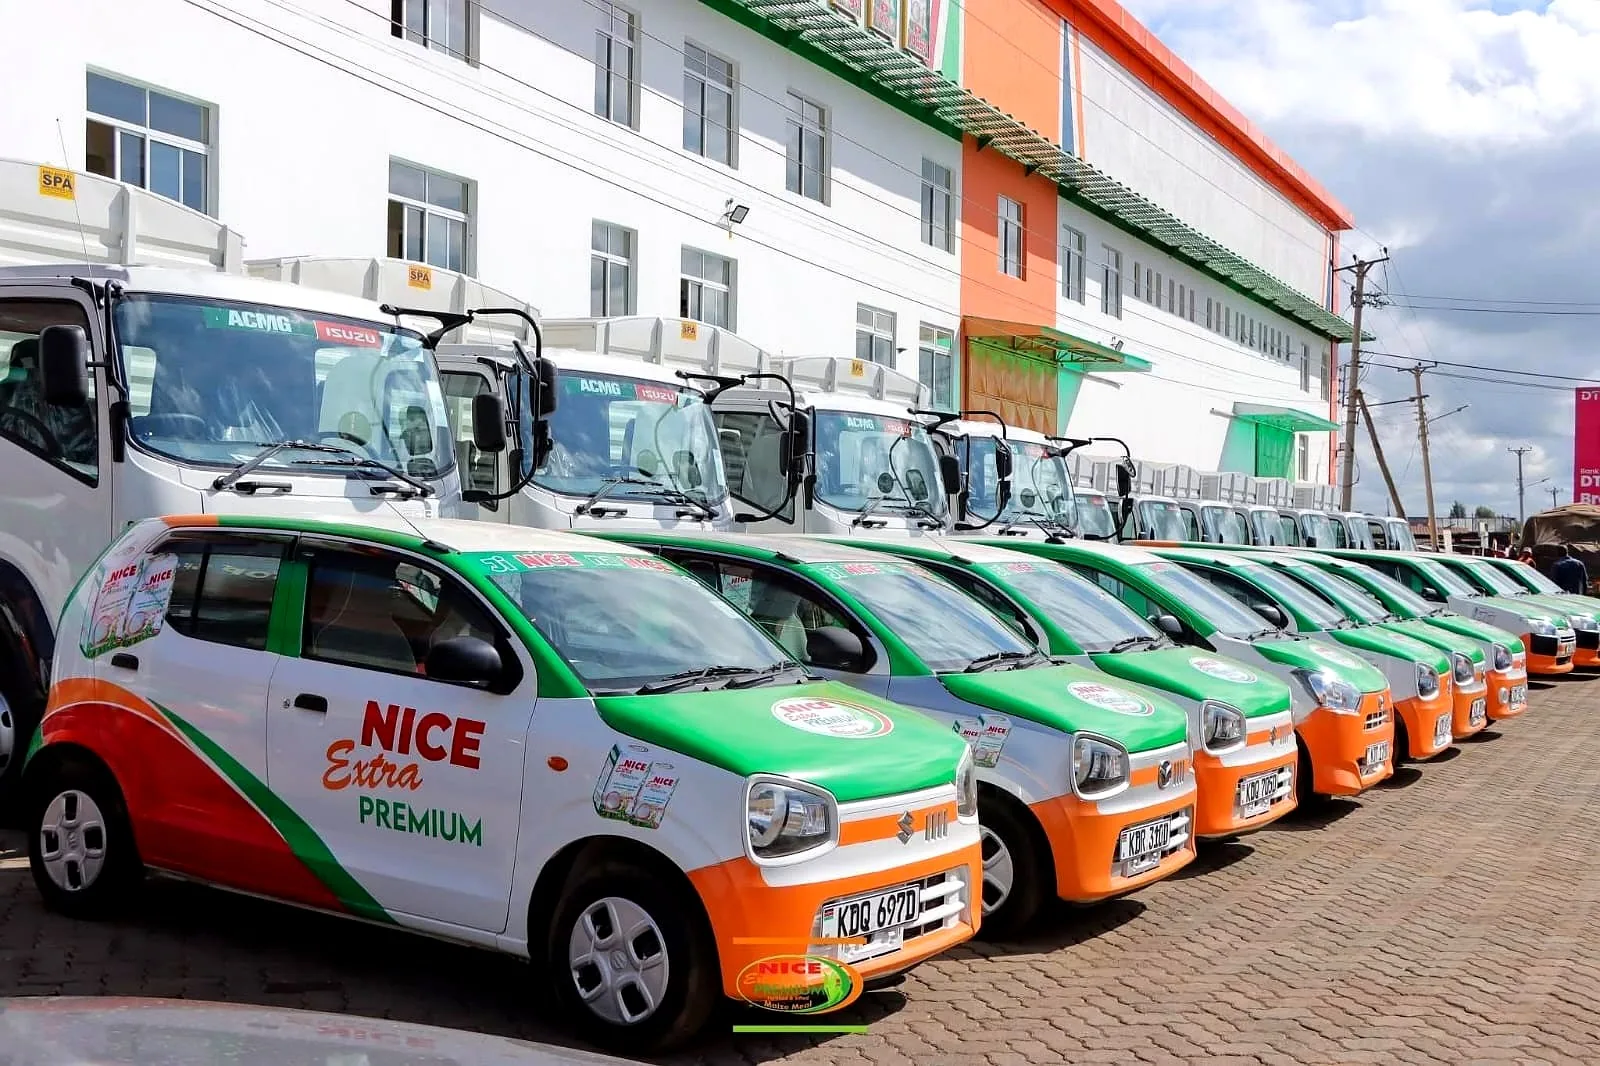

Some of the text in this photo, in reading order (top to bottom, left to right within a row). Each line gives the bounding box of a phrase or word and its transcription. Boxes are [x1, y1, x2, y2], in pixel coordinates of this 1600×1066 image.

[43, 174, 72, 190] SPA
[410, 270, 430, 283] SPA
[228, 310, 293, 332] ACMG
[326, 327, 376, 344] ISUZU
[641, 389, 675, 401] ISUZU
[513, 553, 584, 568] NICE
[110, 565, 138, 583] NICE
[149, 569, 173, 585] NICE
[779, 701, 833, 713] NICE
[361, 700, 486, 770] NICE
[988, 726, 1007, 734] NICE
[321, 739, 424, 792] Extra
[623, 759, 647, 772] NICE
[653, 776, 675, 787] NICE
[359, 795, 482, 847] PREMIUM
[1128, 822, 1169, 857] KDR 310D
[837, 889, 916, 938] KDQ 697D
